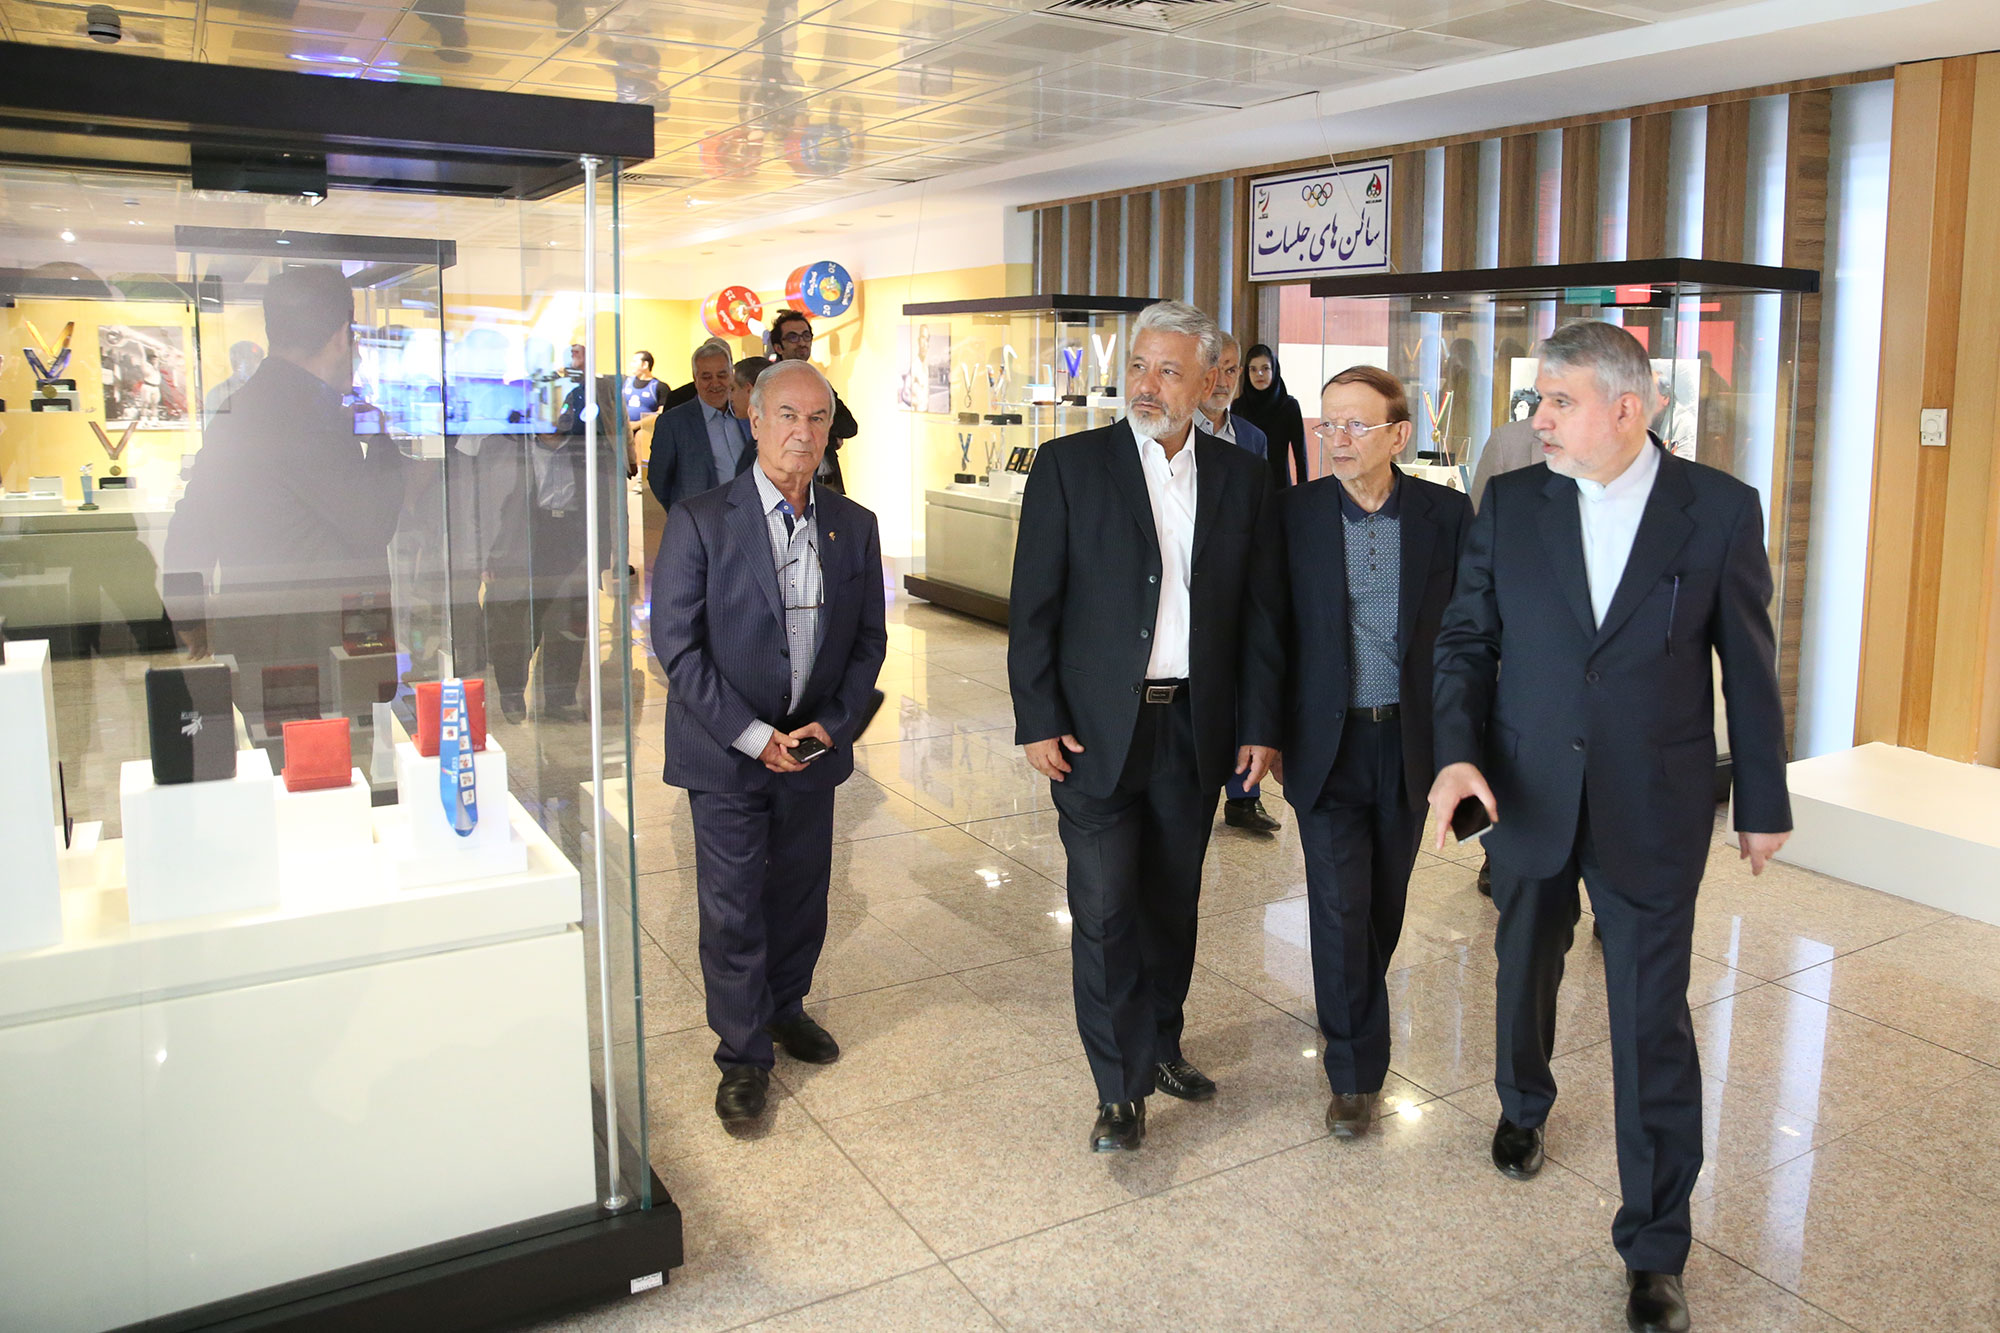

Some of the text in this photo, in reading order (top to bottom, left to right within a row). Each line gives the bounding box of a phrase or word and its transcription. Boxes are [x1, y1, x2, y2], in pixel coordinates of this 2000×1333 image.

[1258, 207, 1380, 262] سالن های جلسات
[828, 262, 837, 274] 20
[724, 289, 736, 301] 25
[822, 304, 831, 316] 20
